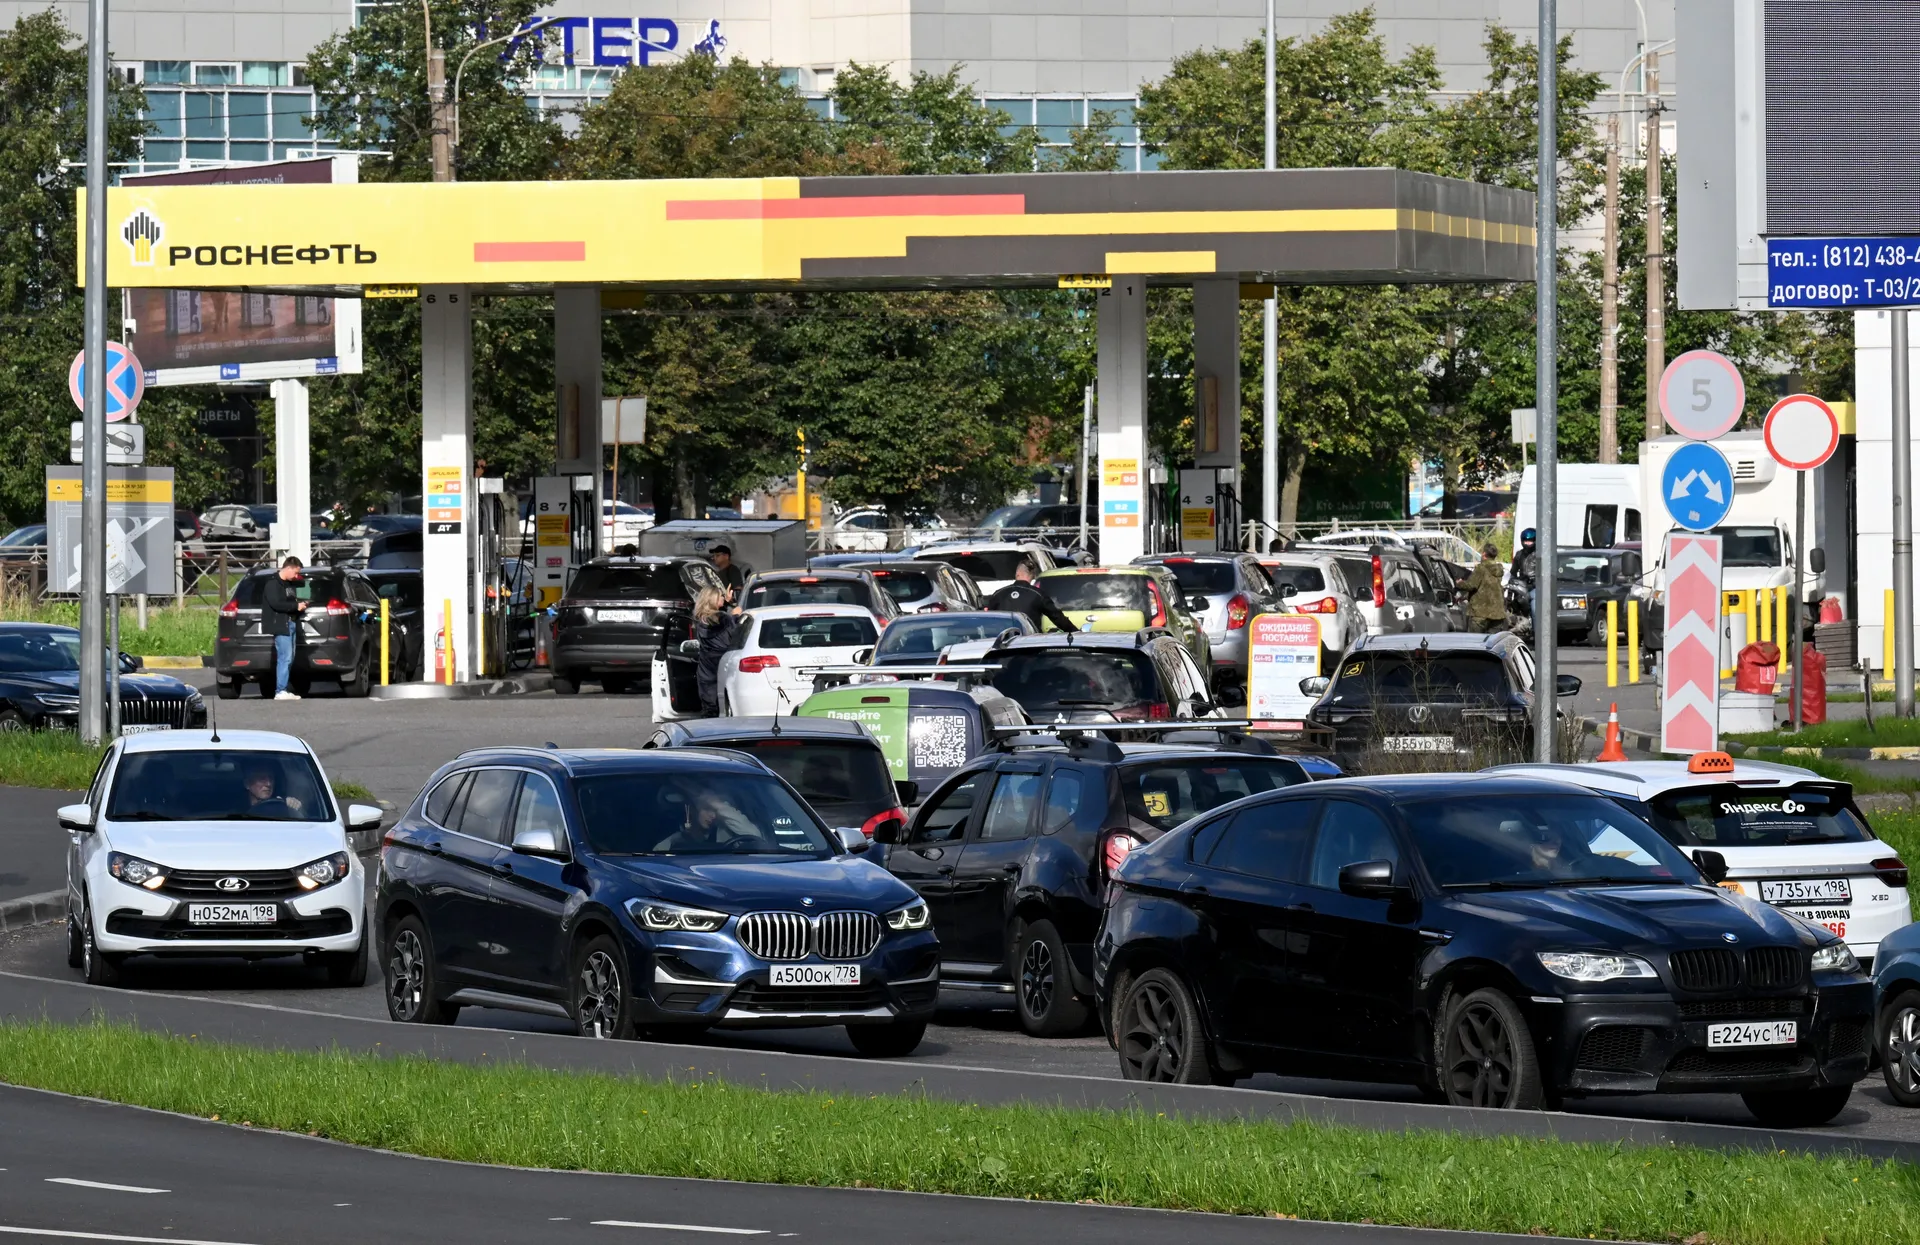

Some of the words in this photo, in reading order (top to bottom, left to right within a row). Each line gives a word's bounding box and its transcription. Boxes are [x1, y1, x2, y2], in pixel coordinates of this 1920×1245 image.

[169, 244, 377, 266] РОСНЕФТЬ
[1771, 251, 1817, 267] тел.:
[1823, 244, 1870, 268] (812)
[1101, 287, 1111, 296] 2
[1772, 284, 1859, 304] договор:
[426, 294, 436, 304] 6
[449, 294, 459, 304] 5
[1691, 378, 1712, 412] 5
[200, 410, 240, 422] ЦВЕТЫ
[540, 502, 549, 512] 8
[558, 502, 568, 512] 7
[1182, 496, 1192, 504] 4
[1205, 496, 1214, 504] 3
[1259, 624, 1312, 634] ОЖИДАНИЕ
[1262, 634, 1308, 642] ПОСТАВКИ
[1720, 802, 1782, 814] Яндекс
[1782, 800, 1805, 814] Go
[1767, 883, 1823, 898] У735УК
[1824, 881, 1844, 892] 198
[194, 906, 249, 920] Н052МА
[252, 906, 273, 917] 198
[1816, 910, 1850, 920] аренду
[776, 968, 832, 983] А500ОК
[836, 966, 856, 978] 778
[1712, 1026, 1770, 1044] Е224УС
[1774, 1023, 1794, 1036] 147
